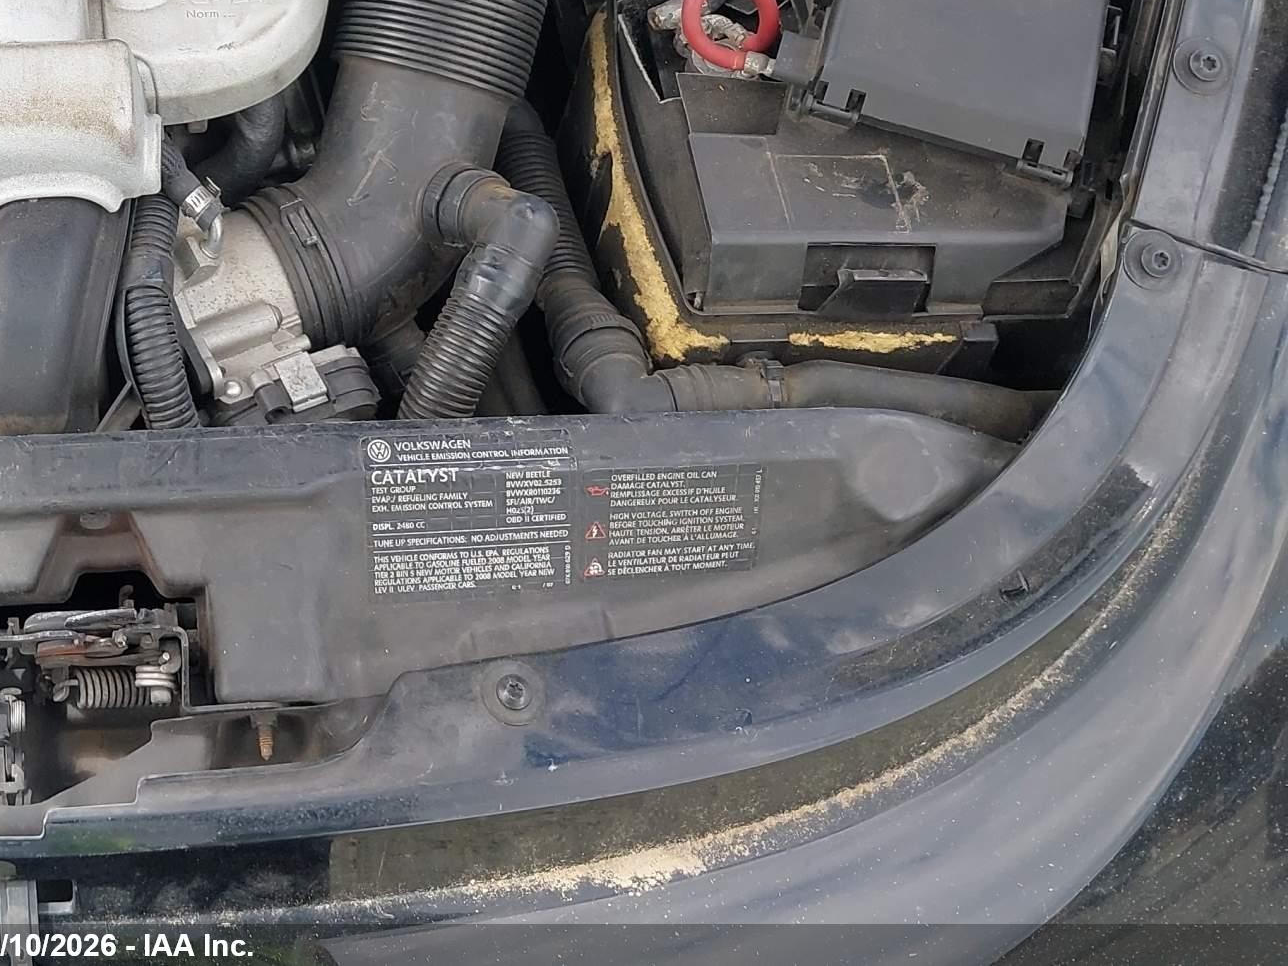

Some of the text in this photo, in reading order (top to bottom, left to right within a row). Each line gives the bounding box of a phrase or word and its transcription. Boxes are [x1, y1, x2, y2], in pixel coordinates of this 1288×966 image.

[394, 439, 471, 451] VOLKSWAGEN
[432, 452, 470, 460] EMISSION
[472, 450, 509, 458] CONTROL
[511, 447, 568, 456] INFORMATION
[372, 467, 459, 484] CATALYST
[611, 473, 655, 481] OVERFILLED
[657, 472, 684, 480] ENGINE
[687, 471, 700, 479] OIL
[611, 482, 644, 490] DAMAGE
[398, 493, 437, 502] REFUELING
[440, 492, 467, 500] FAMILY
[610, 490, 659, 498] REMPLISSAGE
[662, 488, 694, 496] EXCESSIF
[464, 500, 493, 508] SYSTEM
[610, 498, 655, 506] DANGEREUX
[658, 497, 678, 505] POUR
[531, 513, 566, 522] CERTIFIED
[670, 509, 698, 517] SWITCH
[373, 523, 395, 531] DISPL.
[610, 520, 636, 528] BEFORE
[639, 519, 677, 527] TOUCHING
[609, 529, 633, 537] HAUTE
[703, 524, 711, 532] LE
[713, 523, 744, 531] MOTEUR
[374, 539, 394, 548] TUNE
[485, 532, 538, 542] ADJUSTMENTS
[540, 530, 568, 538] NEEDED
[609, 538, 634, 546] AVANT
[648, 535, 681, 543] TOUCHER
[390, 554, 418, 563] VEHICLE
[419, 552, 457, 561] CONFORMS
[502, 546, 549, 556] REGULATIONS
[608, 550, 646, 558] RADIATOR
[647, 549, 662, 557] FAN
[374, 562, 412, 571] APPLICABLE
[414, 561, 424, 569] TO
[426, 559, 460, 568] GASOLINE
[462, 558, 486, 566] FUELED
[506, 555, 531, 563] MODEL
[618, 557, 666, 566] VENTILATEUR
[679, 553, 719, 562] RADIATEUR
[396, 570, 408, 578] BIN
[435, 567, 460, 576] MOTOR
[461, 565, 492, 574] VEHICLES
[511, 561, 551, 570] CALIFORNIA
[375, 577, 421, 586] REGULATIONS
[423, 574, 462, 583] APPLICABLE
[493, 571, 517, 579] MODEL
[539, 568, 555, 576] NEW
[419, 582, 456, 591] PASSENGER
